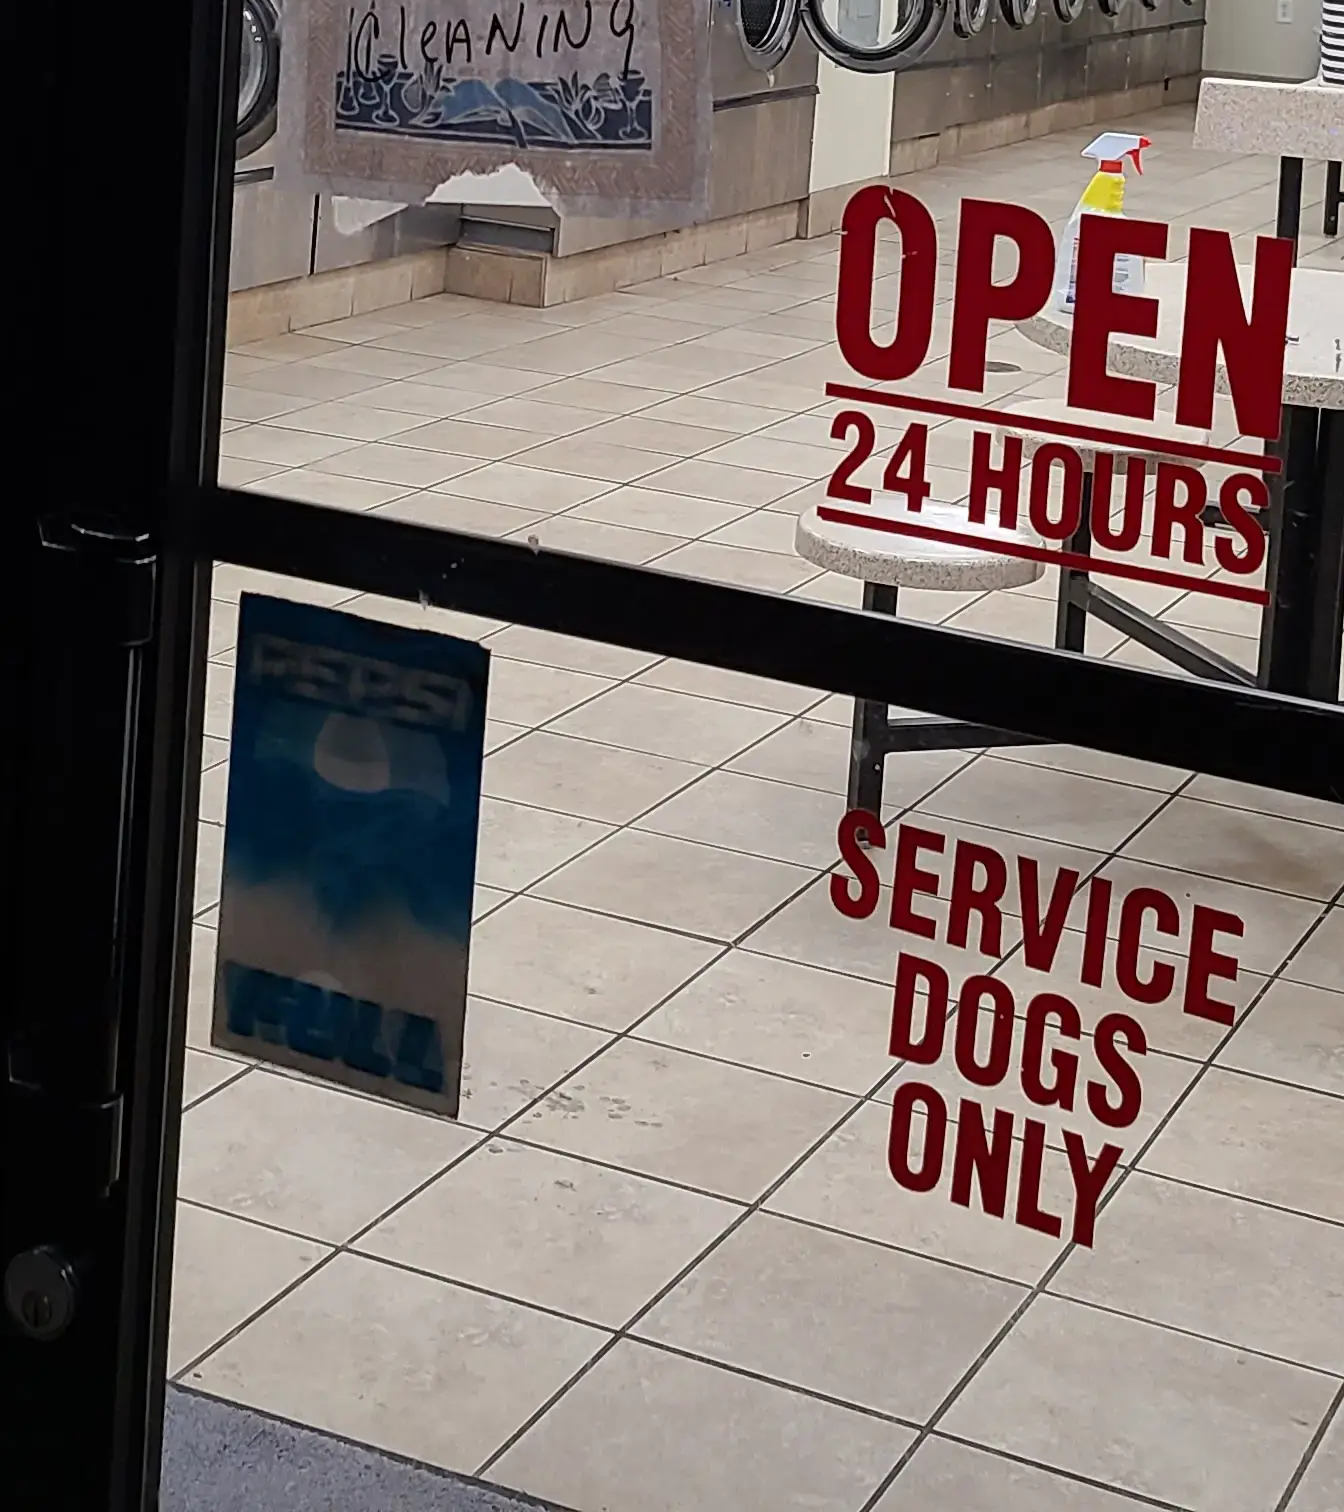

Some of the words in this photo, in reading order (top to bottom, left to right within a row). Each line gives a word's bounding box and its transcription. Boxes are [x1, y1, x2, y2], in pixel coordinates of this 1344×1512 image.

[836, 184, 1294, 440] OPEN
[826, 411, 932, 514] 24
[967, 430, 1271, 574] HOURS
[829, 808, 1245, 1027] SERVICE
[887, 951, 1148, 1128] DOGS
[887, 1081, 1125, 1249] ONLY
